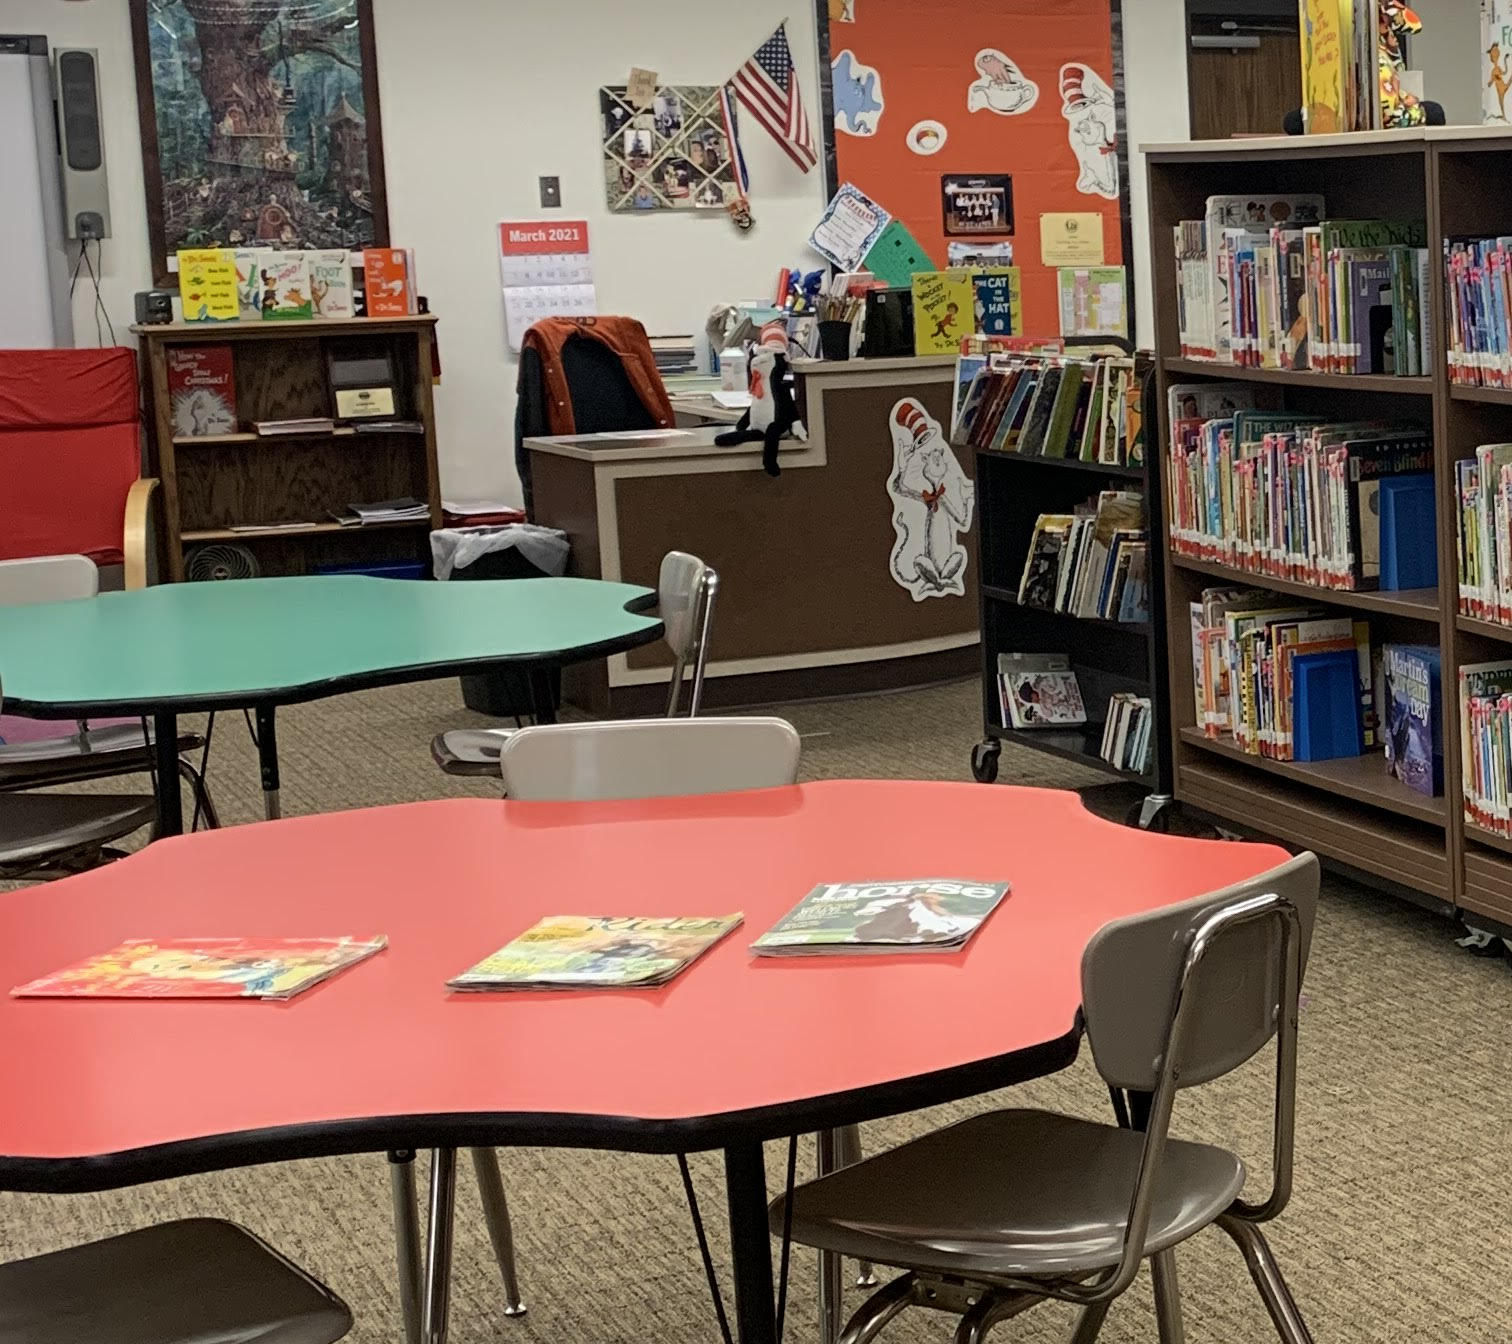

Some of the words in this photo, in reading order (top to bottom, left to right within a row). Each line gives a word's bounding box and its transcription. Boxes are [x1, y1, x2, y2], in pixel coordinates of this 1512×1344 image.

[509, 229, 546, 242] March
[548, 228, 579, 241] 2021
[987, 277, 1007, 288] CAT
[988, 303, 1009, 314] HAT
[1254, 422, 1271, 433] THE
[1410, 697, 1430, 728] Day
[821, 883, 997, 902] horse
[586, 916, 724, 932] Rider
